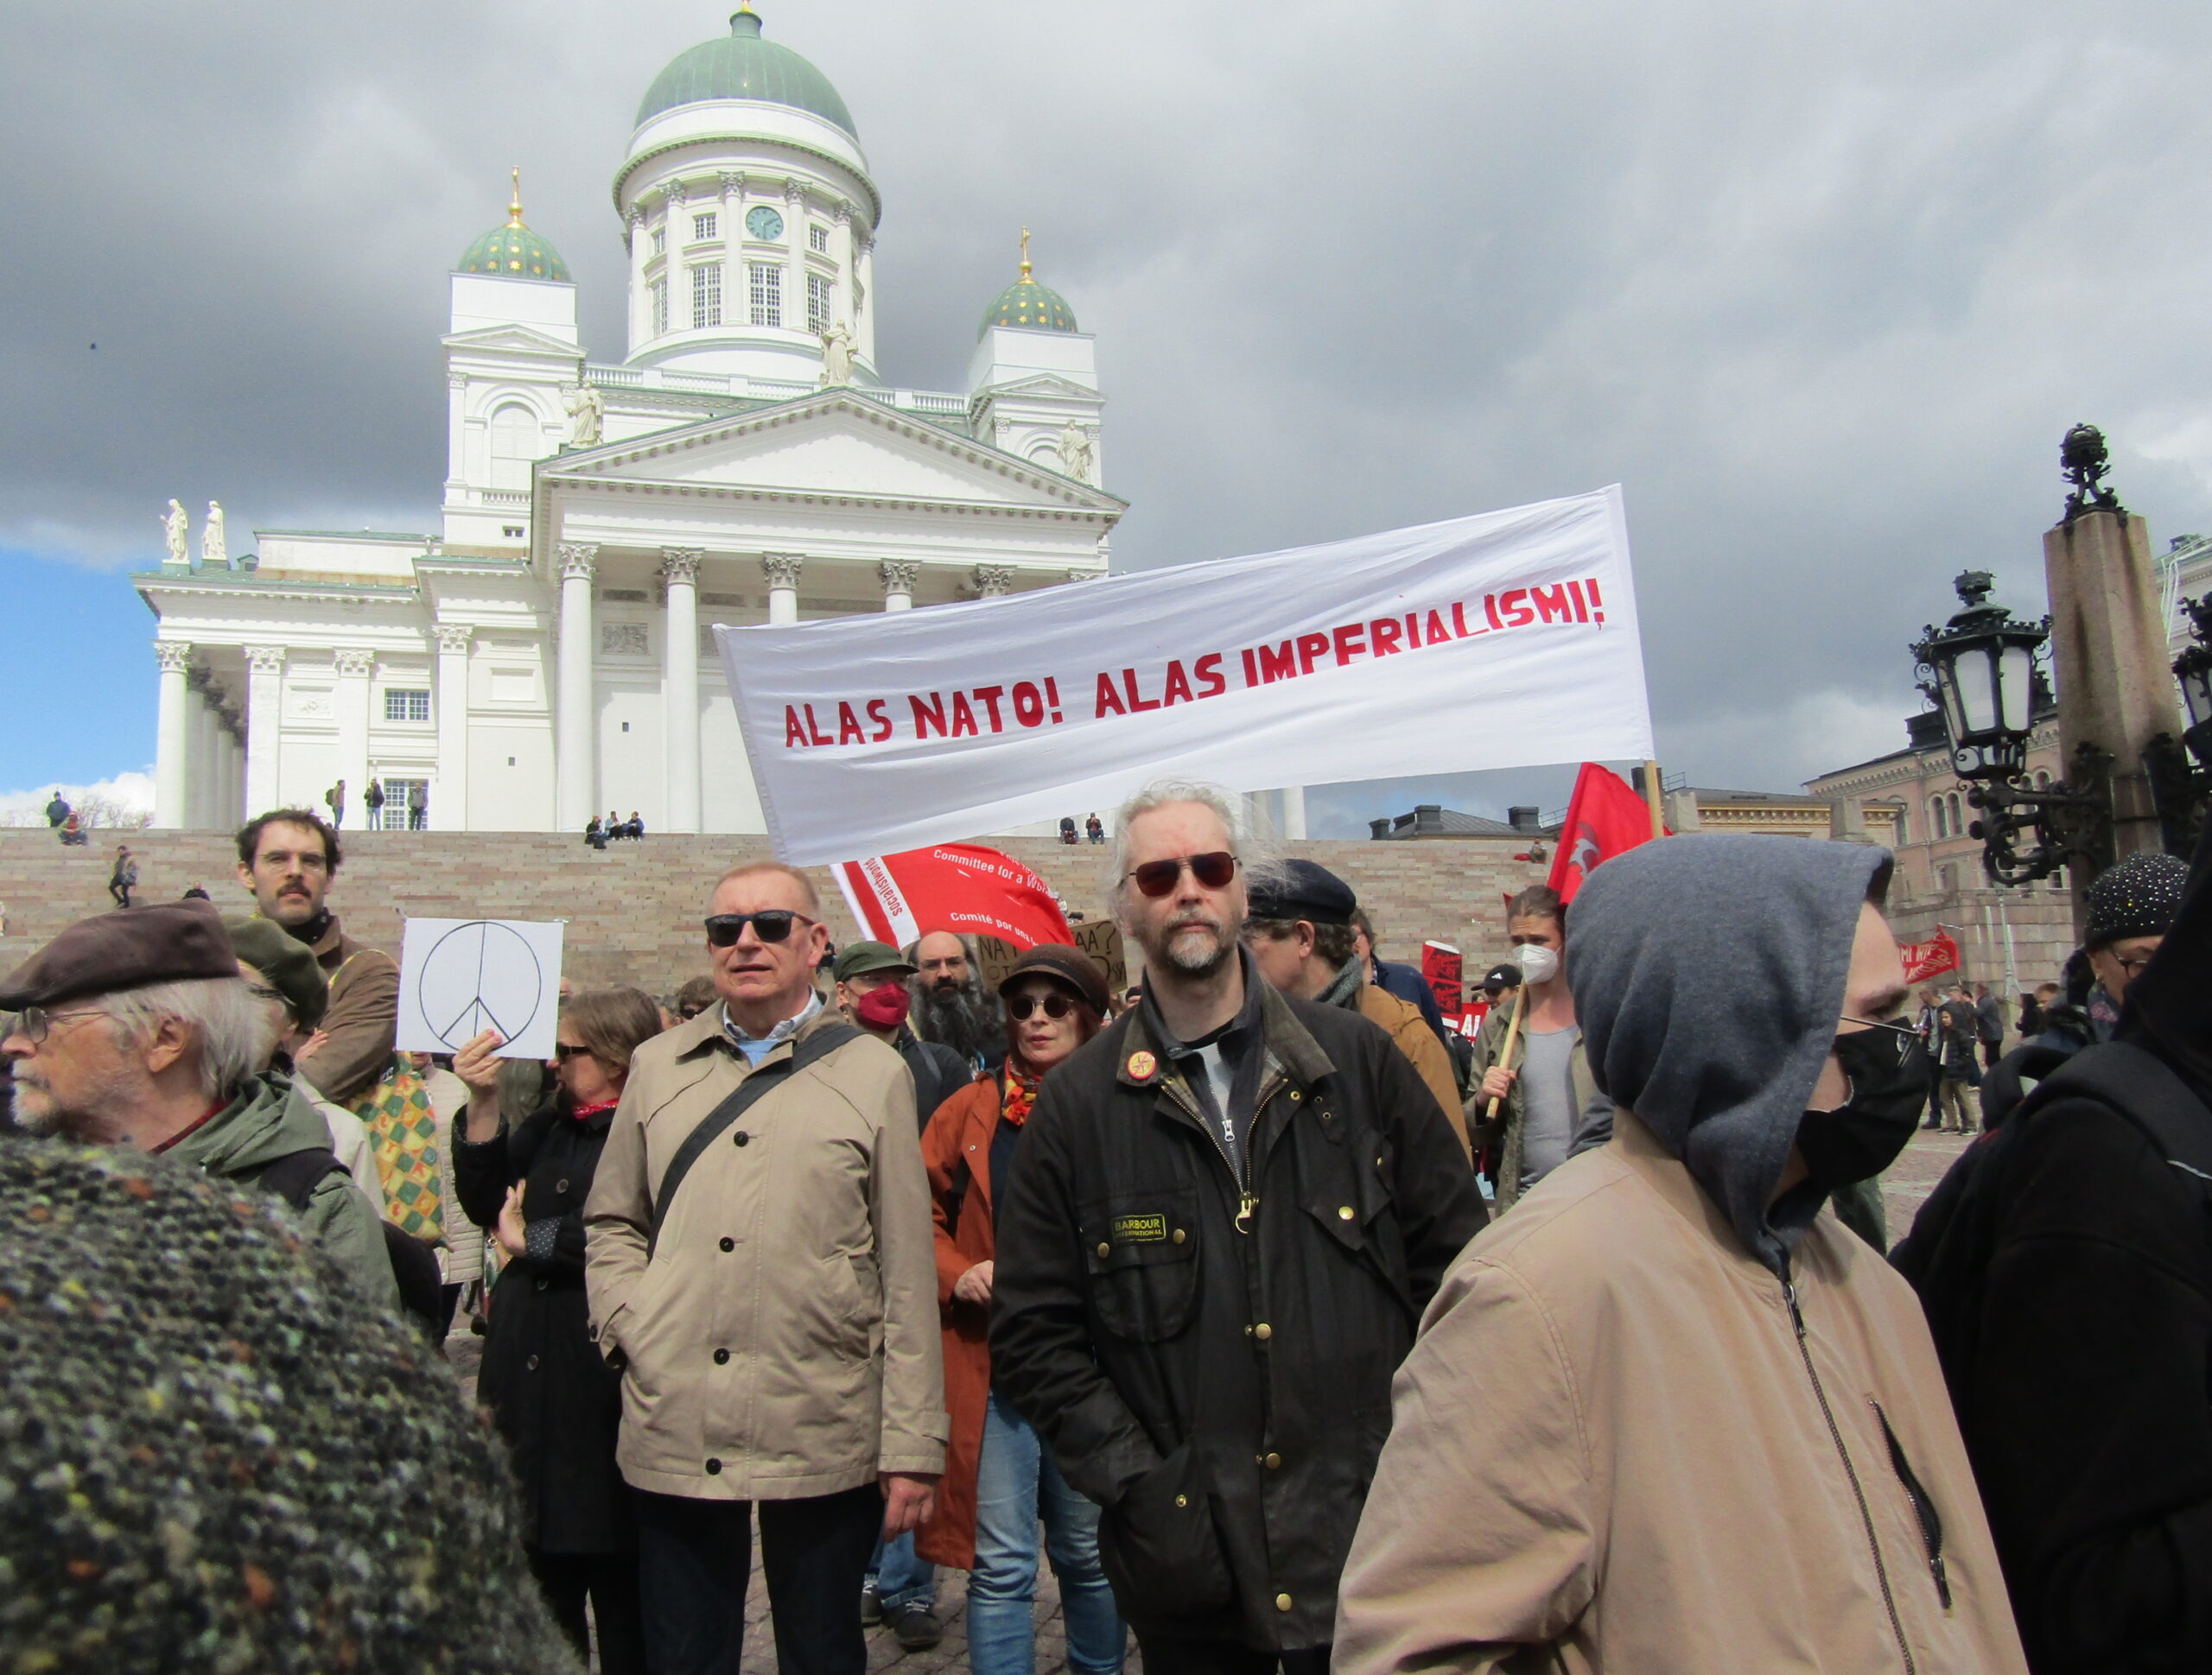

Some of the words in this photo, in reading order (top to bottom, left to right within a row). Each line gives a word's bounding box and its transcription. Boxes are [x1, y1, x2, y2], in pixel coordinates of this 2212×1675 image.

[785, 699, 893, 747] ALAS
[907, 676, 1064, 739] NATO!
[1095, 652, 1226, 719] ALAS
[933, 848, 995, 873] Committee
[997, 864, 1014, 880] for
[1015, 873, 1024, 885] a
[950, 911, 994, 924] Comité
[995, 918, 1013, 932] por
[1115, 1219, 1160, 1231] BARBOUR
